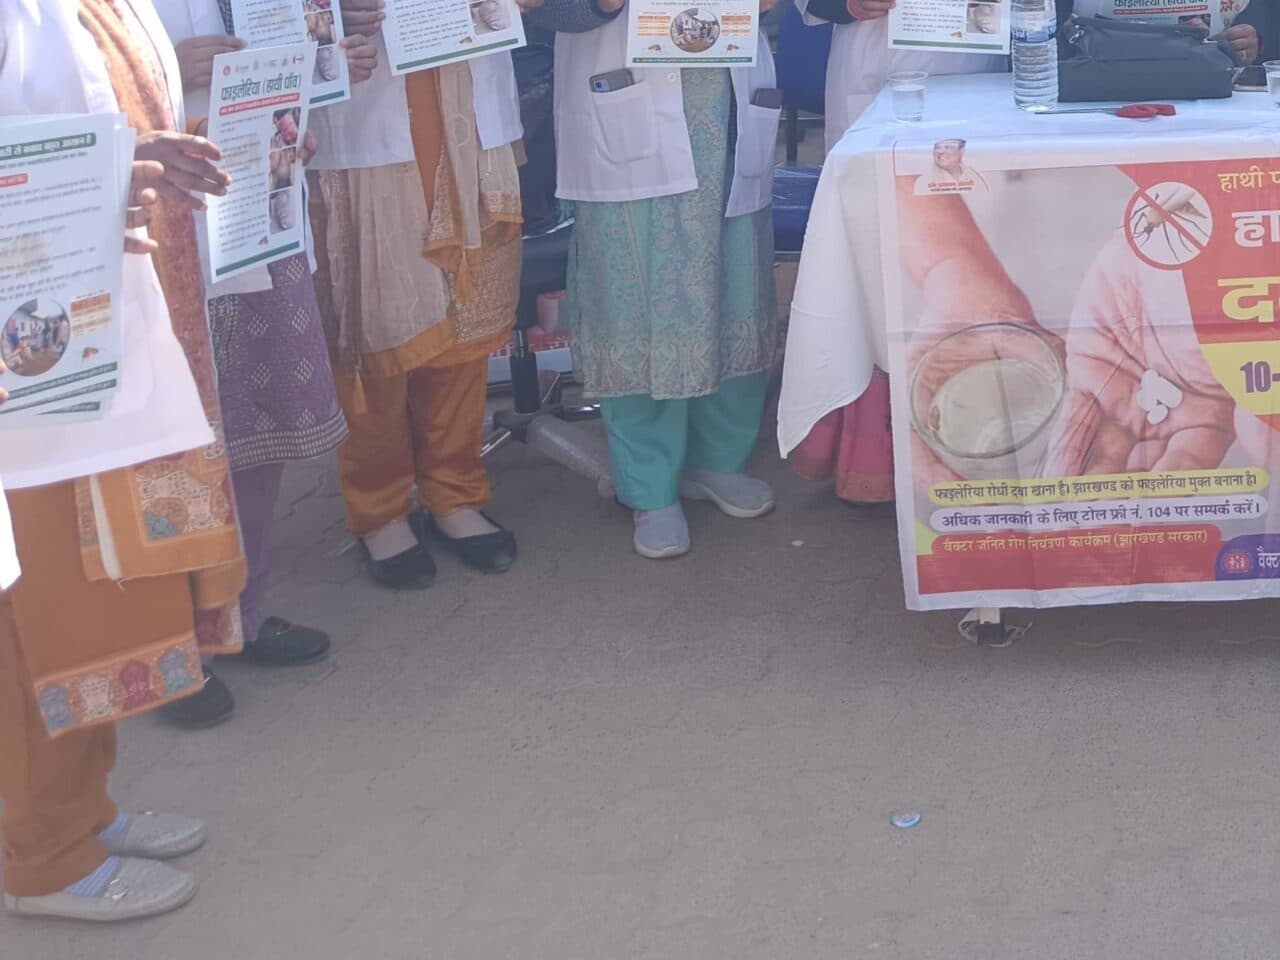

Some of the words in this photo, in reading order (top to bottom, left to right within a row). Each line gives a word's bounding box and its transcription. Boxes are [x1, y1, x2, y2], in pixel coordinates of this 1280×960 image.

[1218, 166, 1264, 193] हाथी
[935, 483, 984, 501] फाइलेरिया
[988, 482, 1008, 498] रोधी
[1031, 484, 1056, 498] खाना
[1073, 481, 1117, 497] झारखण्ड
[1119, 476, 1134, 491] को
[1138, 474, 1186, 492] फाइलेरिया
[1189, 477, 1211, 493] मुक्त
[1214, 474, 1243, 487] बनाना
[942, 512, 981, 527] अधिक
[984, 511, 1033, 526] जानकारी
[1037, 510, 1050, 524] के
[1053, 509, 1078, 525] लिए
[1082, 506, 1107, 521] टोल
[1109, 505, 1126, 520] फ्री
[1149, 506, 1170, 518] 104
[1174, 505, 1190, 517] पर
[1193, 499, 1230, 516] सम्पर्क
